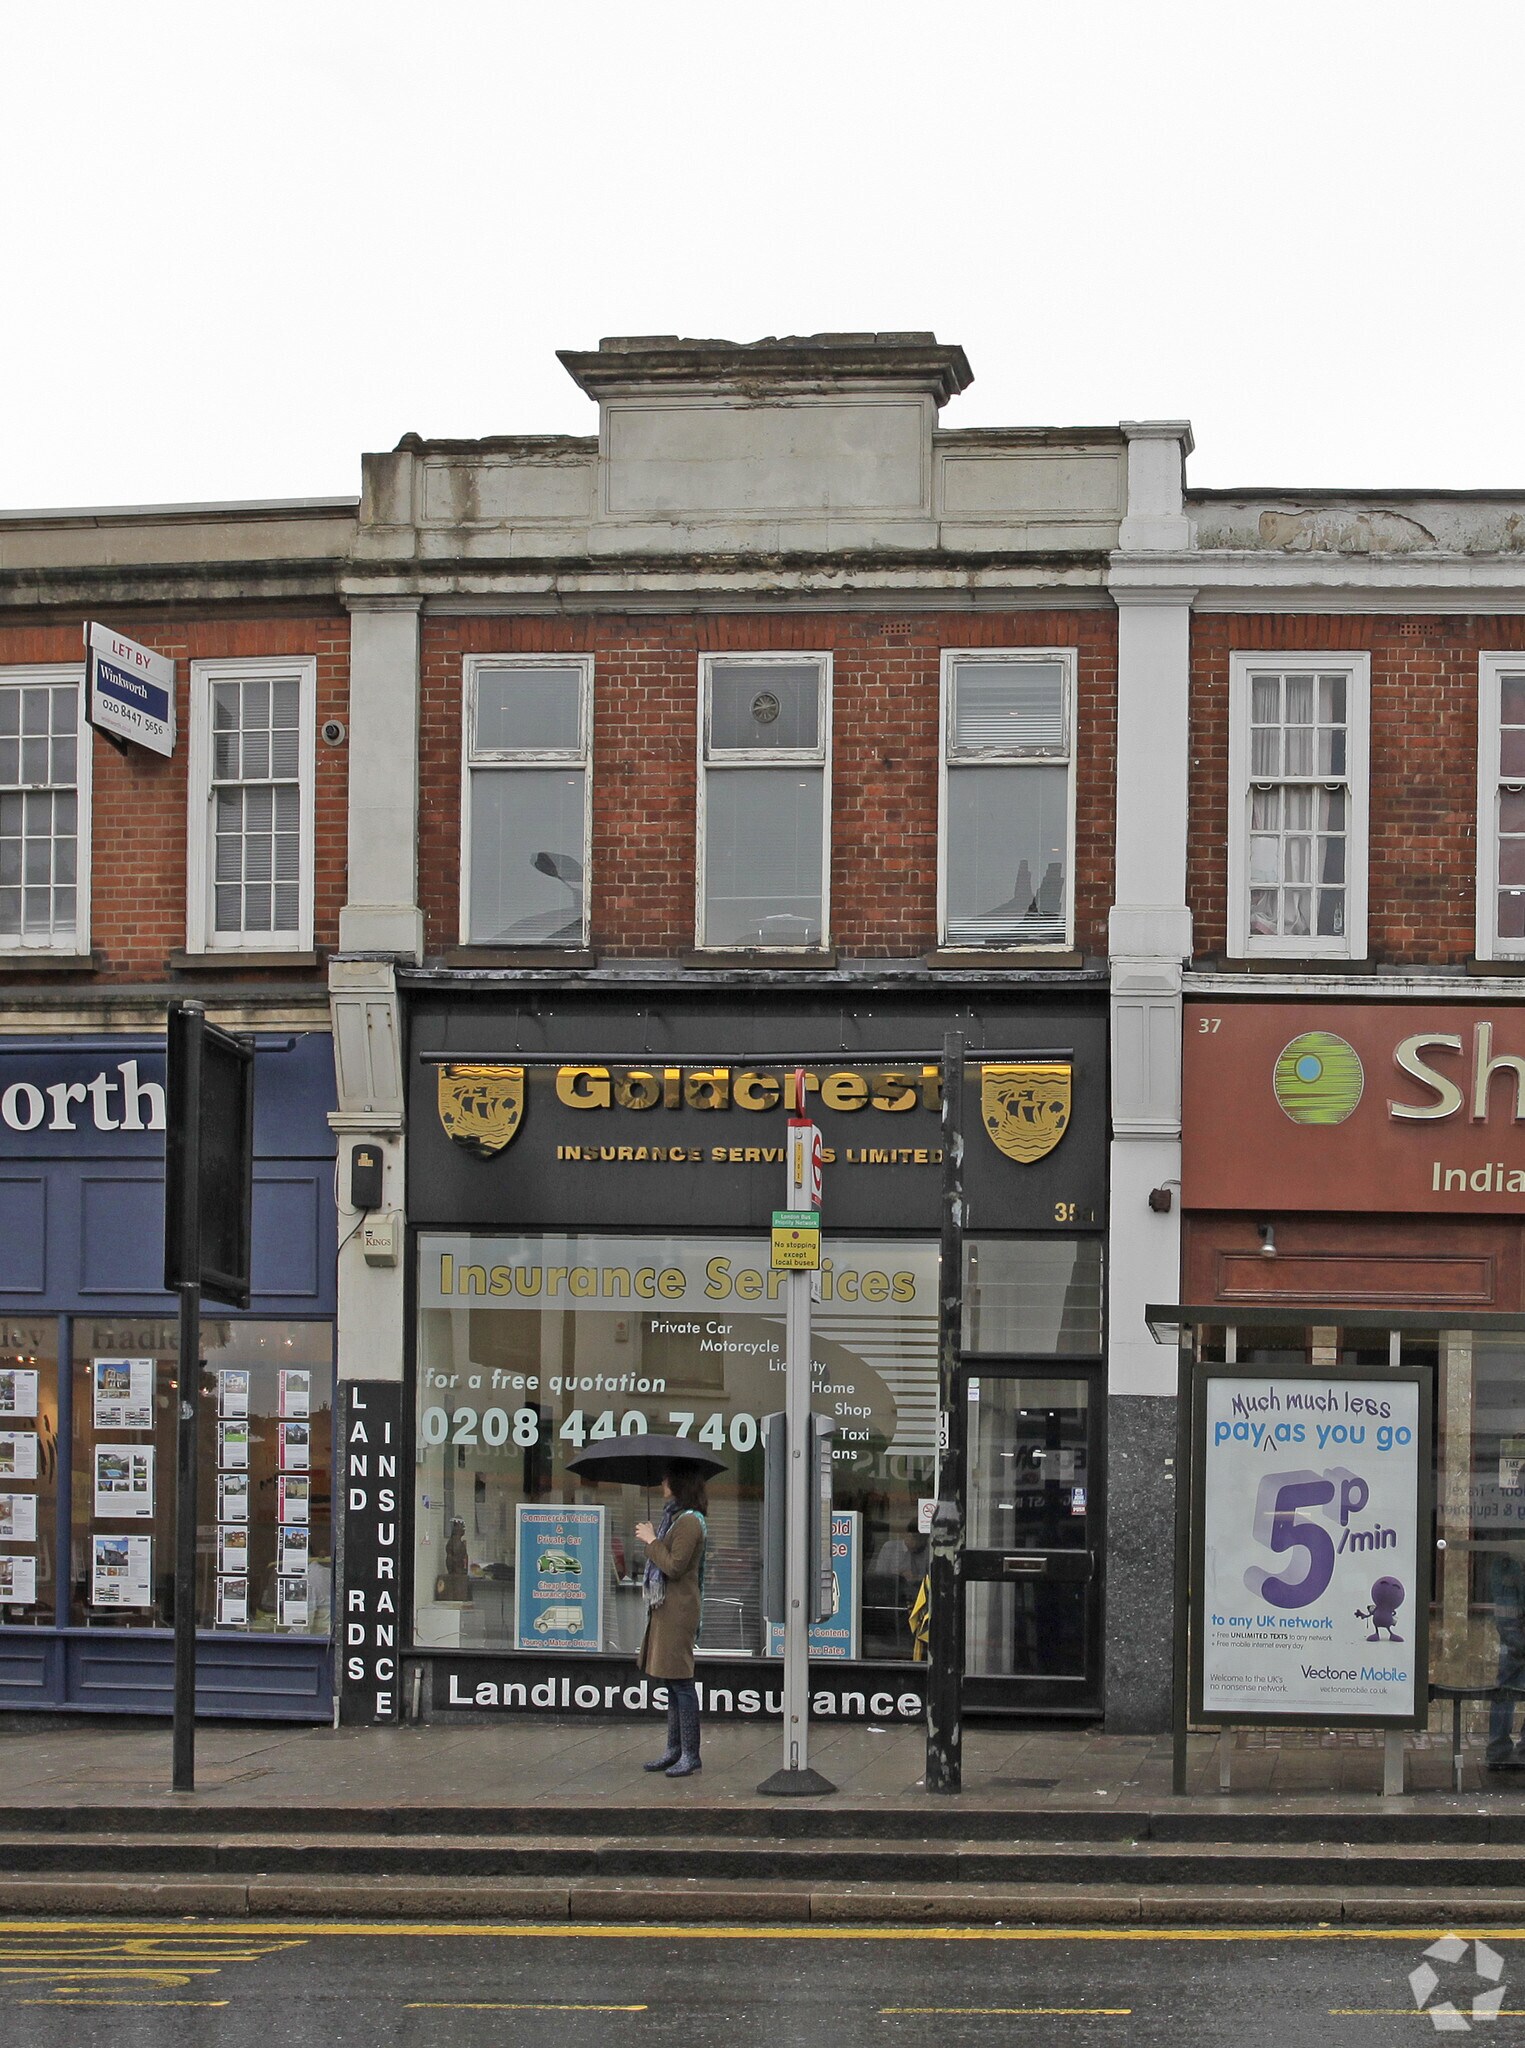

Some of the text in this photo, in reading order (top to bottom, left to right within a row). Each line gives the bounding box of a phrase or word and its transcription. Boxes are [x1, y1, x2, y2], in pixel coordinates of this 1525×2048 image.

[112, 640, 151, 669] LET BY
[100, 664, 148, 699] Winkworth
[102, 699, 164, 735] 020 8447 5656
[1198, 1018, 1222, 1034] 37
[1, 1059, 166, 1131] orth
[556, 1066, 943, 1111] Goldcrest
[557, 1146, 702, 1161] INSURANCE
[711, 1147, 836, 1163] SERVIS
[786, 1242, 816, 1250] stopping
[440, 1253, 686, 1299] Insurance
[703, 1256, 916, 1303] Serices
[651, 1320, 733, 1335] Private Car
[700, 1339, 780, 1356] Motorcycle
[425, 1368, 666, 1396] for a free quotation
[811, 1380, 855, 1394] Home
[834, 1402, 872, 1419] Shop
[1232, 1386, 1391, 1419] Much much less
[421, 1406, 539, 1447] 0208
[559, 1410, 648, 1448] 440
[669, 1412, 766, 1452] 740
[840, 1427, 869, 1441] Taxi
[1215, 1421, 1412, 1451] pay as you go
[831, 1449, 857, 1460] ans
[522, 1512, 598, 1524] Commercial Vehicle
[537, 1534, 582, 1545] Private Car
[375, 1421, 396, 1714] INSURANCE
[538, 1580, 582, 1591] Cheap Motor
[532, 1590, 586, 1599] Insurance Deals
[1212, 1614, 1333, 1630] to any UK network
[814, 1628, 850, 1638] Contents
[1230, 1632, 1268, 1640] UNLIMITED
[823, 1646, 845, 1655] Rates
[1210, 1673, 1244, 1682] Welcome
[1245, 1674, 1252, 1682] to
[1301, 1665, 1408, 1681] Vectone Mobile
[449, 1674, 922, 1716] Landlords Insuance
[1221, 1684, 1256, 1692] nonsense
